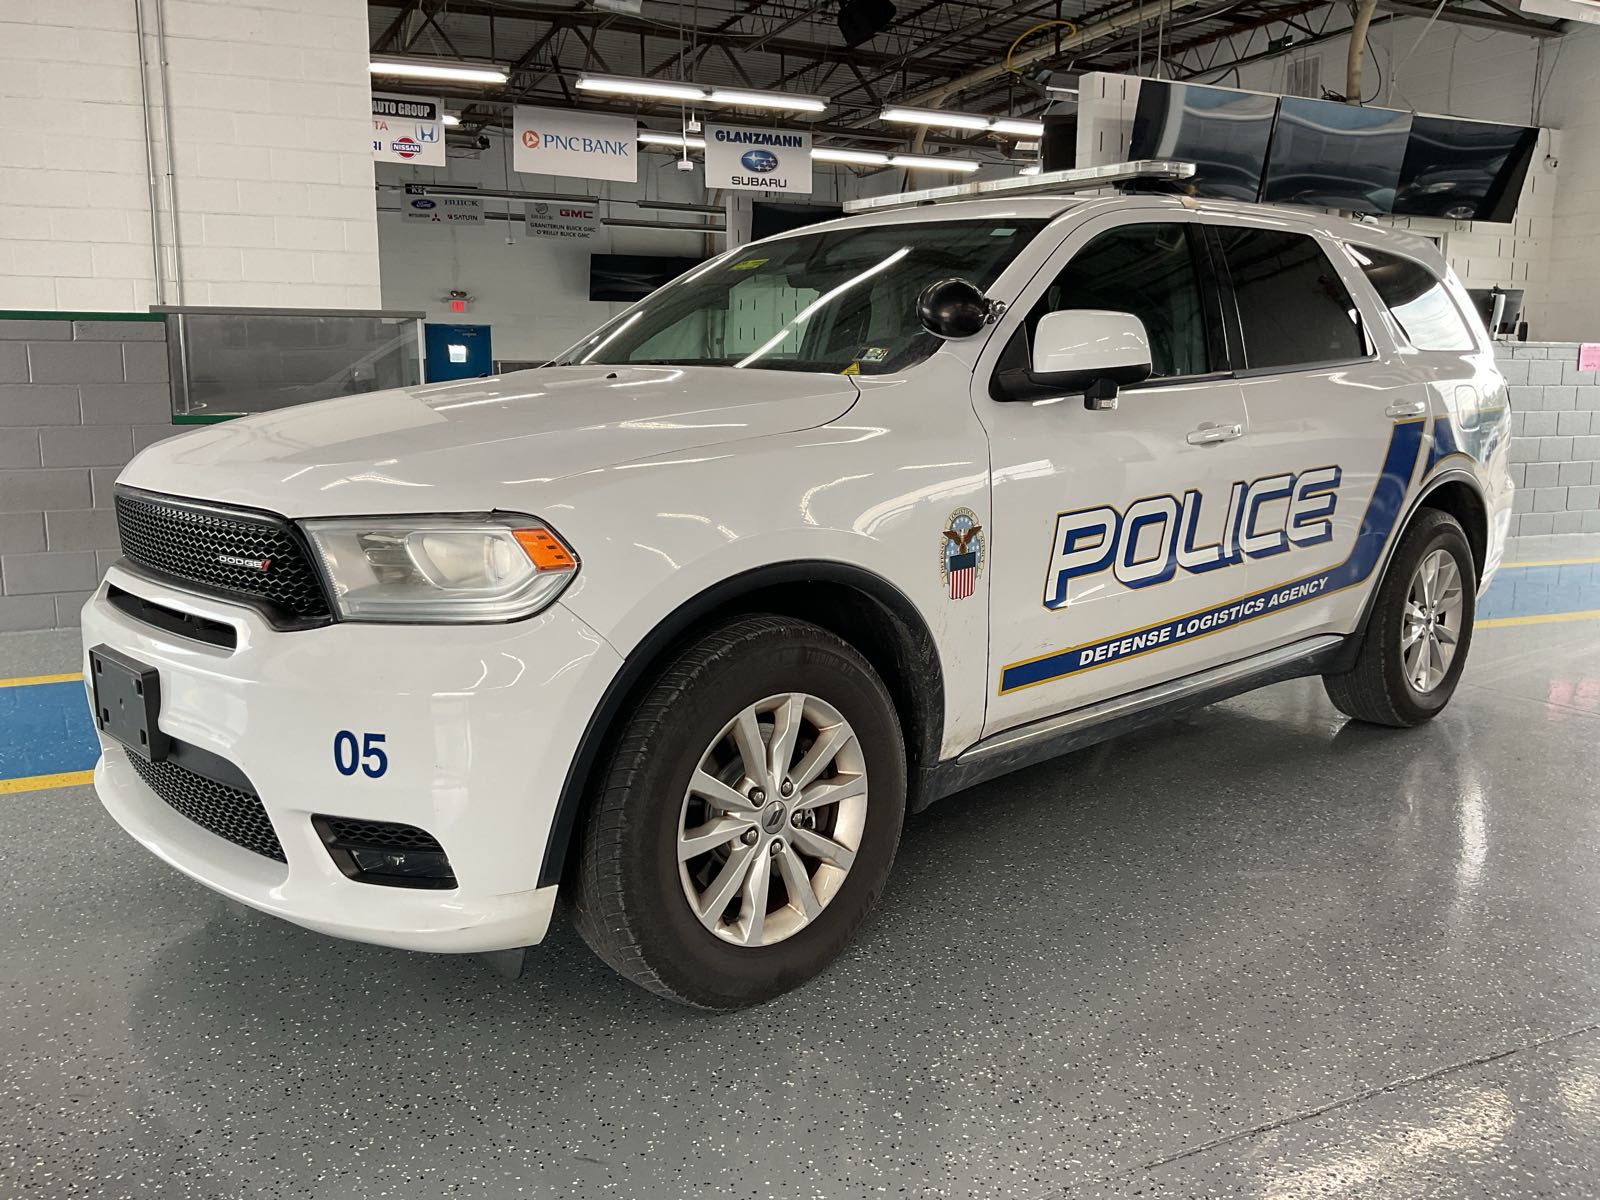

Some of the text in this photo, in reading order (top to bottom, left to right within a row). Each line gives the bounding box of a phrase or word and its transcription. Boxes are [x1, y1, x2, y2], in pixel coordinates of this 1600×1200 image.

[398, 103, 430, 117] GROUP
[543, 133, 629, 156] PNC BANK
[715, 130, 803, 148] GLANZMANN
[393, 144, 420, 152] NISSAN
[731, 176, 787, 188] SUBARU
[560, 209, 594, 219] GMC
[1043, 464, 1342, 610] POLICE
[219, 555, 263, 569] DODGE
[1079, 576, 1329, 667] DEFENSE LOGISTICS AGENCY
[333, 729, 389, 779] 05
